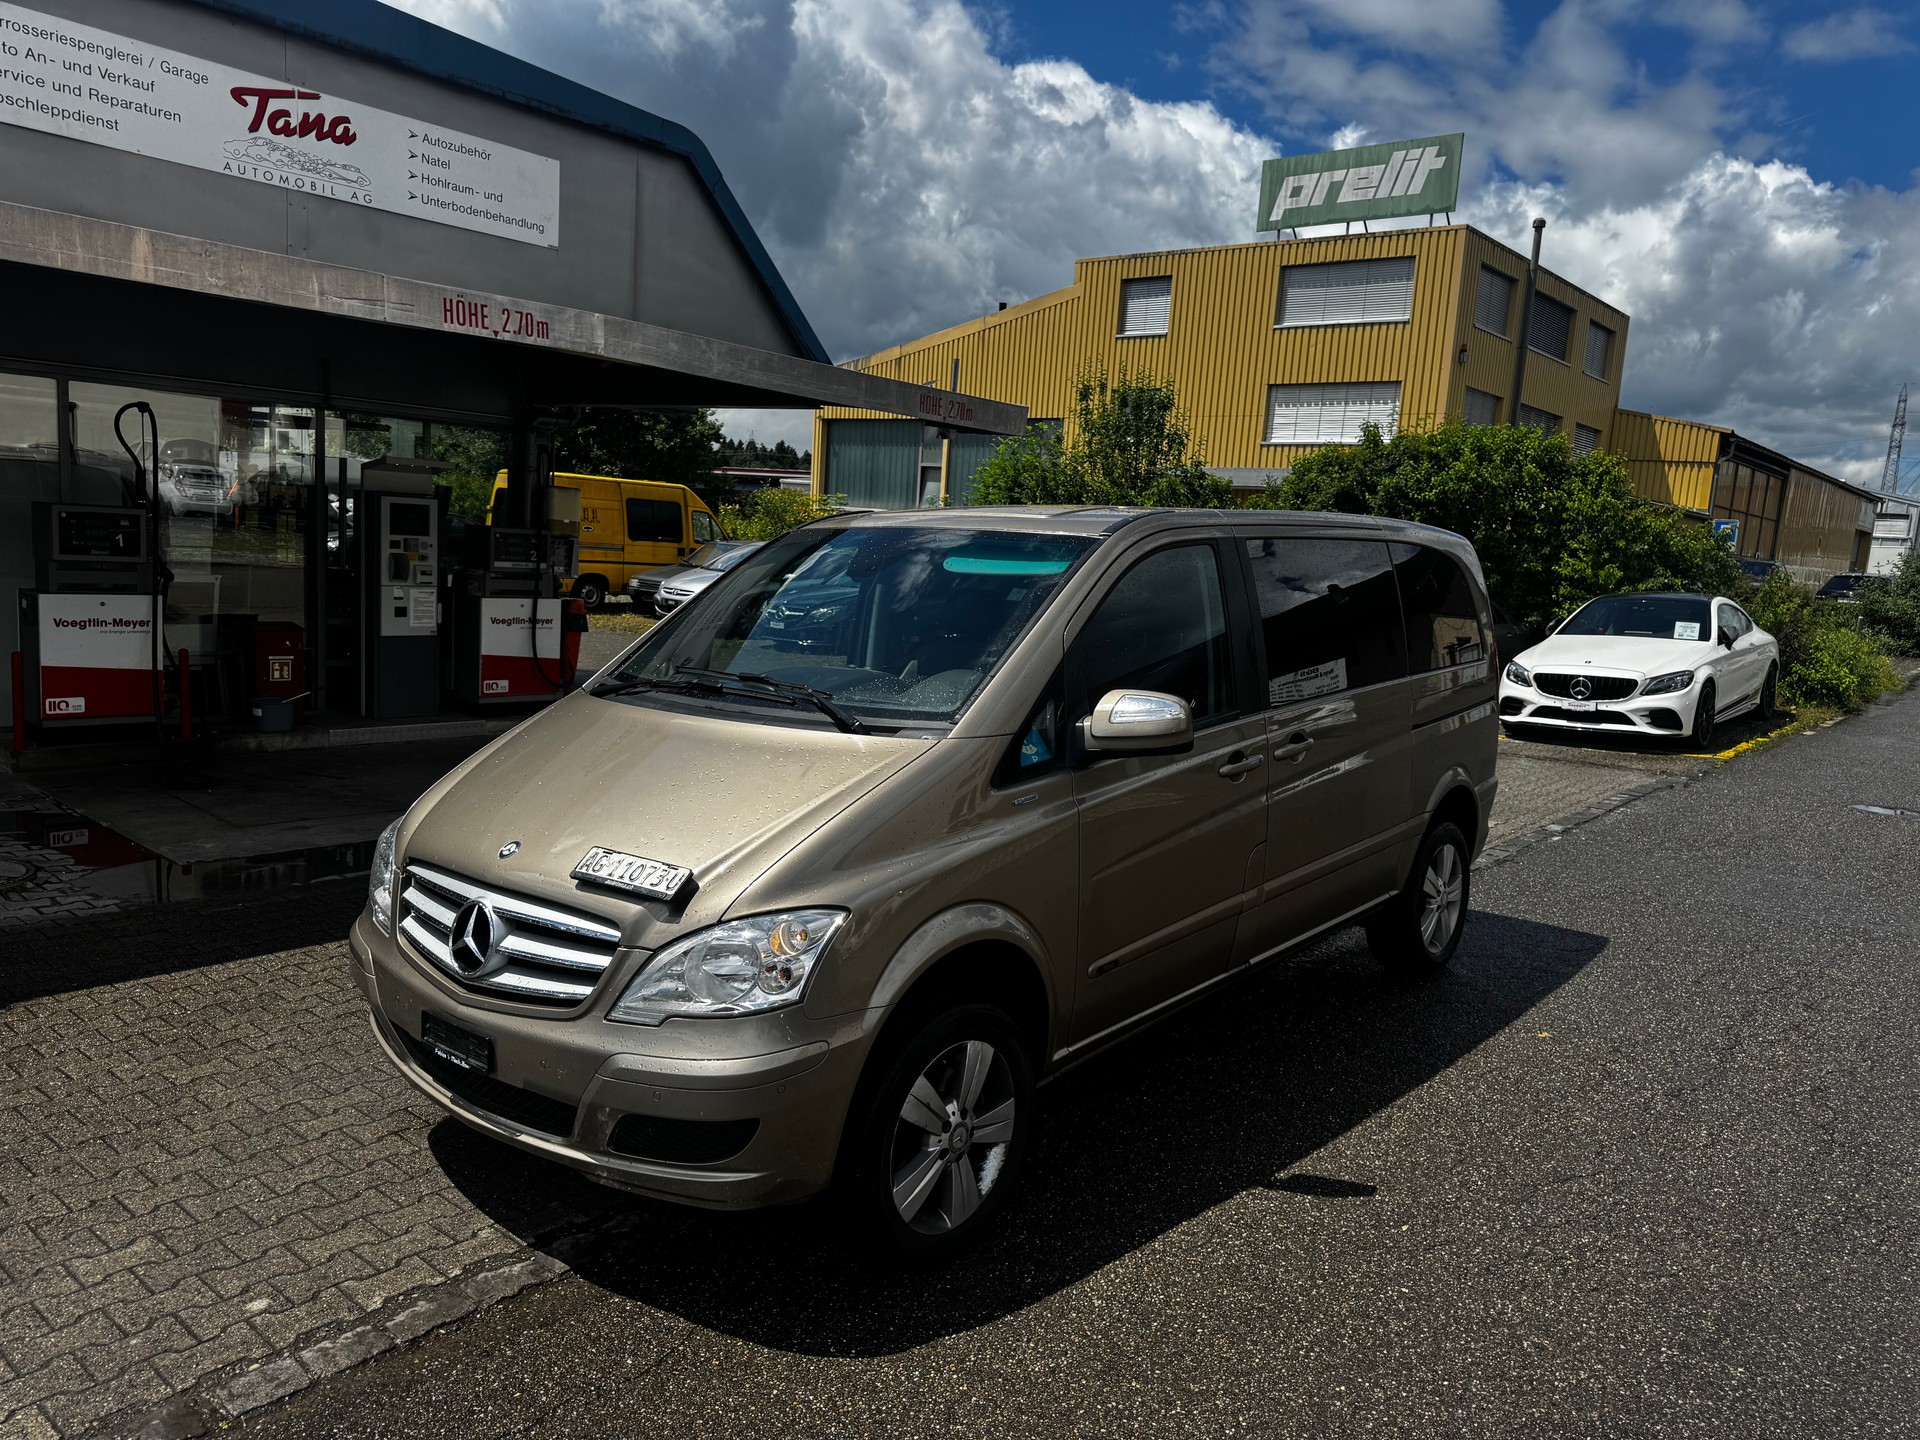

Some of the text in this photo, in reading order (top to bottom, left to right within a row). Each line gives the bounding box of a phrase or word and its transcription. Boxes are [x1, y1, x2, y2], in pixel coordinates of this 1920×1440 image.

[25, 47, 56, 64] An-
[62, 59, 92, 76] und
[97, 65, 155, 93] Verkauf
[160, 60, 209, 85] Garage
[52, 80, 82, 97] und
[89, 87, 182, 123] Reparaturen
[230, 86, 357, 147] Tana
[421, 153, 451, 170] Natel
[422, 133, 492, 161] Autozubehör
[223, 161, 373, 204] AUTOMOBIL AG
[421, 173, 503, 203] Hohlraum- und
[1269, 145, 1447, 222] prelit
[421, 193, 545, 235] Unterbodenbehandlung
[443, 294, 489, 330] HÖHE
[115, 533, 124, 547] 1
[530, 550, 538, 561] 2
[53, 618, 151, 630] Voegtlin-Meyer
[579, 851, 608, 873] AG
